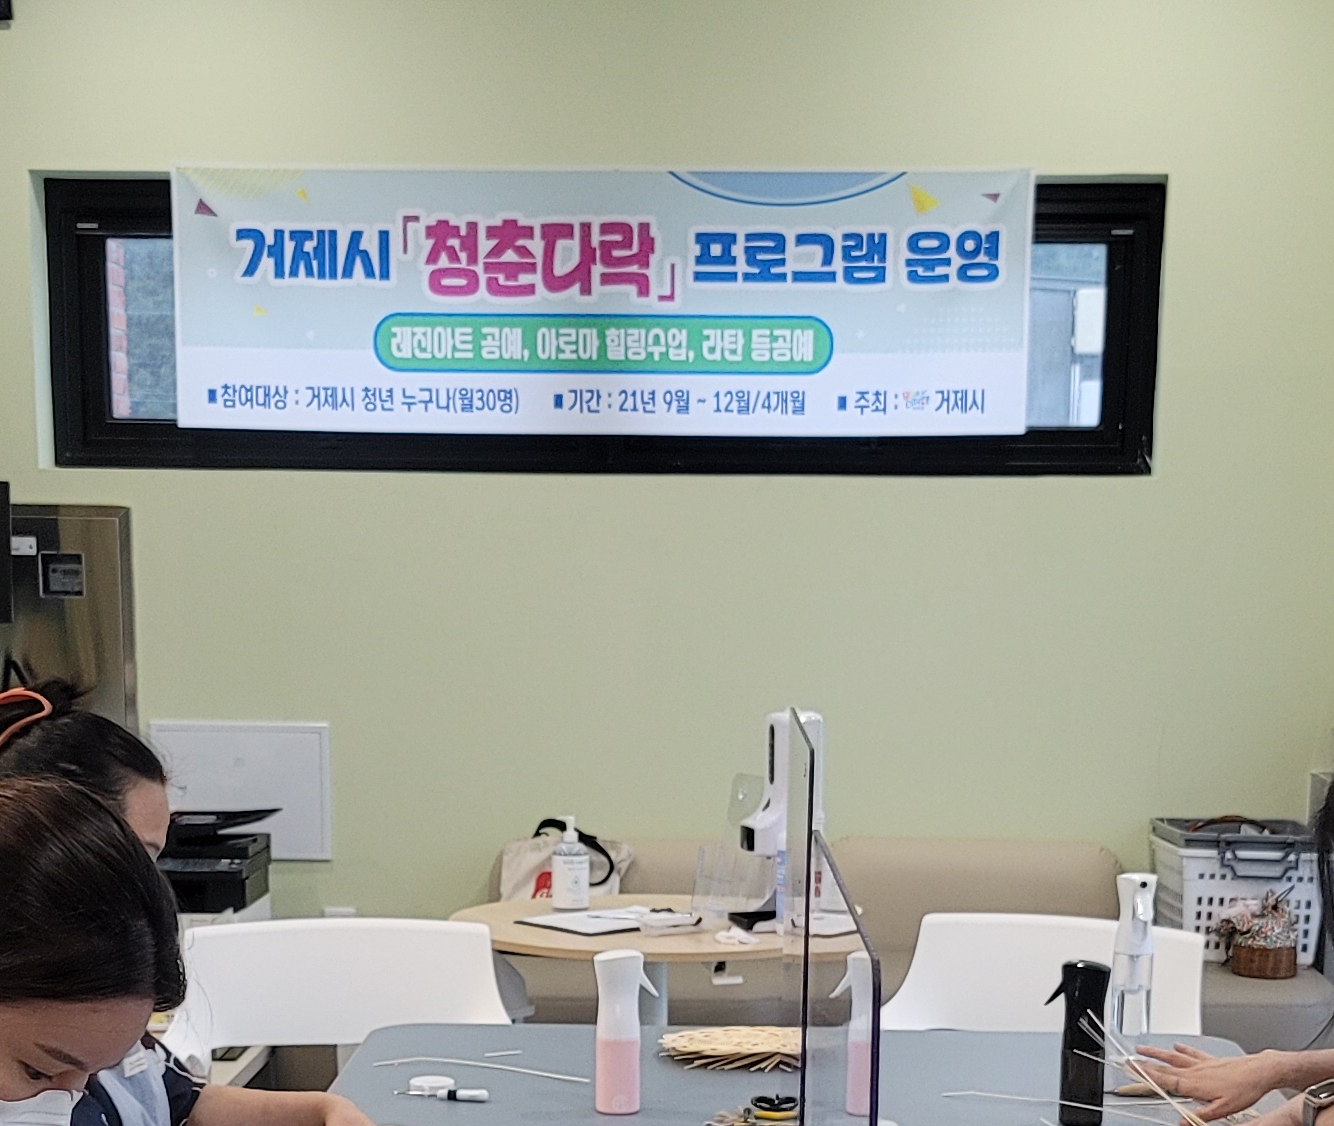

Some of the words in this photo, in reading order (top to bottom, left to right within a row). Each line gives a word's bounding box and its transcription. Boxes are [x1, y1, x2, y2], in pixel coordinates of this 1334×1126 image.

[235, 228, 389, 281] 거제시
[692, 232, 887, 284] 프로그램
[905, 230, 1000, 284] 운영
[390, 326, 474, 359] 레진아트
[480, 326, 530, 362] 공예,
[536, 327, 600, 361] 아로마
[605, 327, 694, 363] 힐링수업,
[701, 328, 745, 362] 라탄
[750, 328, 815, 362] 등공예
[221, 383, 289, 411] 참여대상
[305, 386, 355, 412] 거제시
[361, 386, 395, 413] 청년
[400, 387, 519, 415] 누구나(월30명)
[568, 388, 602, 414] 기간
[618, 389, 656, 414] 21년
[663, 389, 690, 415] 9월
[713, 390, 806, 416] 12월/4개월
[854, 390, 887, 415] 주최
[935, 389, 985, 415] 거제시
